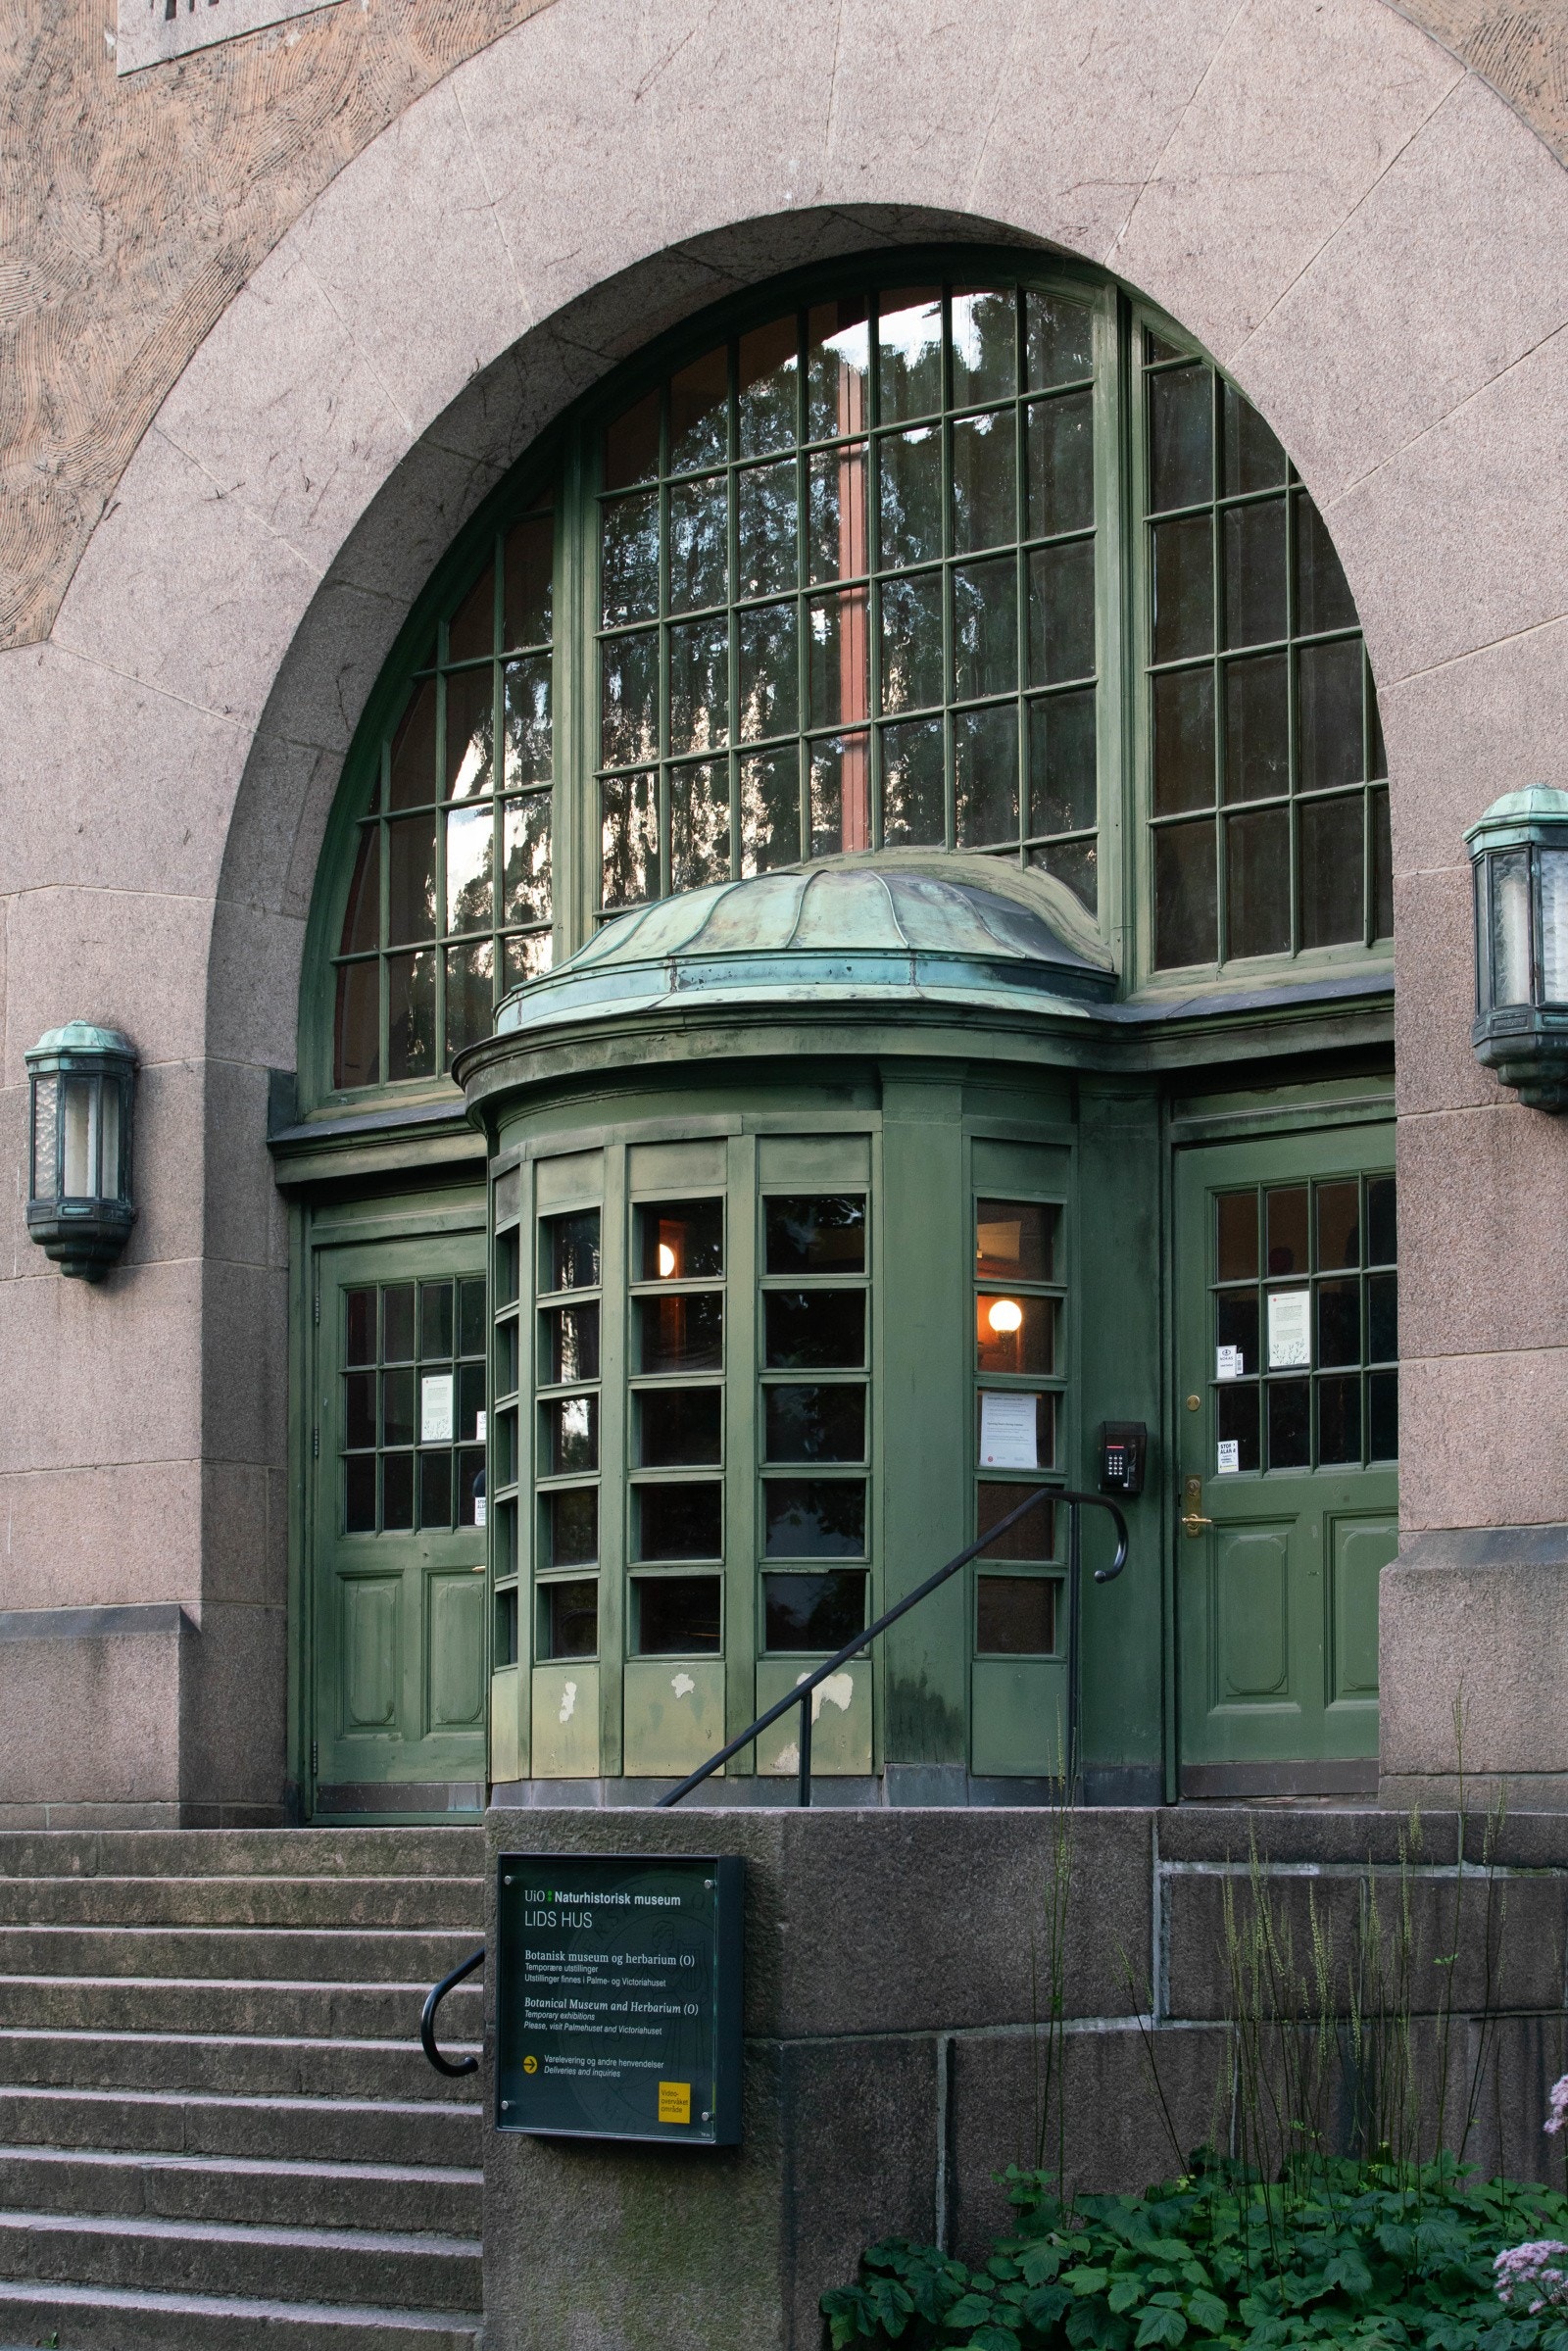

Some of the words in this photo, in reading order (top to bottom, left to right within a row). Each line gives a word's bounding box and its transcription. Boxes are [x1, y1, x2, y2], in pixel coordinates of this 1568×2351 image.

[554, 1890, 631, 1905] Naturhistorisk
[634, 1895, 681, 1906] museum
[524, 1910, 557, 1928] LIDS
[561, 1911, 593, 1929] HUS
[524, 1949, 565, 1961] Botanisk
[567, 1953, 609, 1963] museum
[611, 1954, 623, 1966] og
[625, 1952, 676, 1966] herbarium
[525, 1962, 563, 1973] Temporære
[564, 1964, 599, 1975] utstillinger
[524, 1973, 560, 1984] Utstillinger
[561, 1975, 581, 1984] finnes
[586, 1976, 610, 1985] Palme-
[611, 1979, 621, 1987] og
[621, 1977, 666, 1987] Victoriahuset
[524, 1996, 567, 2009] Botanical
[568, 1998, 609, 2011] Museum
[610, 2000, 628, 2012] and
[630, 2001, 681, 2014] Herbarium
[524, 2009, 560, 2021] Temporary
[560, 2011, 596, 2021] exhibitions
[523, 2020, 549, 2031] Please,
[549, 2022, 564, 2031] visit
[564, 2022, 604, 2033] Palmehuset
[604, 2025, 617, 2033] and
[618, 2025, 662, 2035] Victoriahuset
[544, 2054, 585, 2067] Varelevering
[586, 2058, 596, 2067] og
[597, 2058, 617, 2067] andre
[618, 2058, 664, 2069] henvendelser
[544, 2065, 576, 2076] Deliveries
